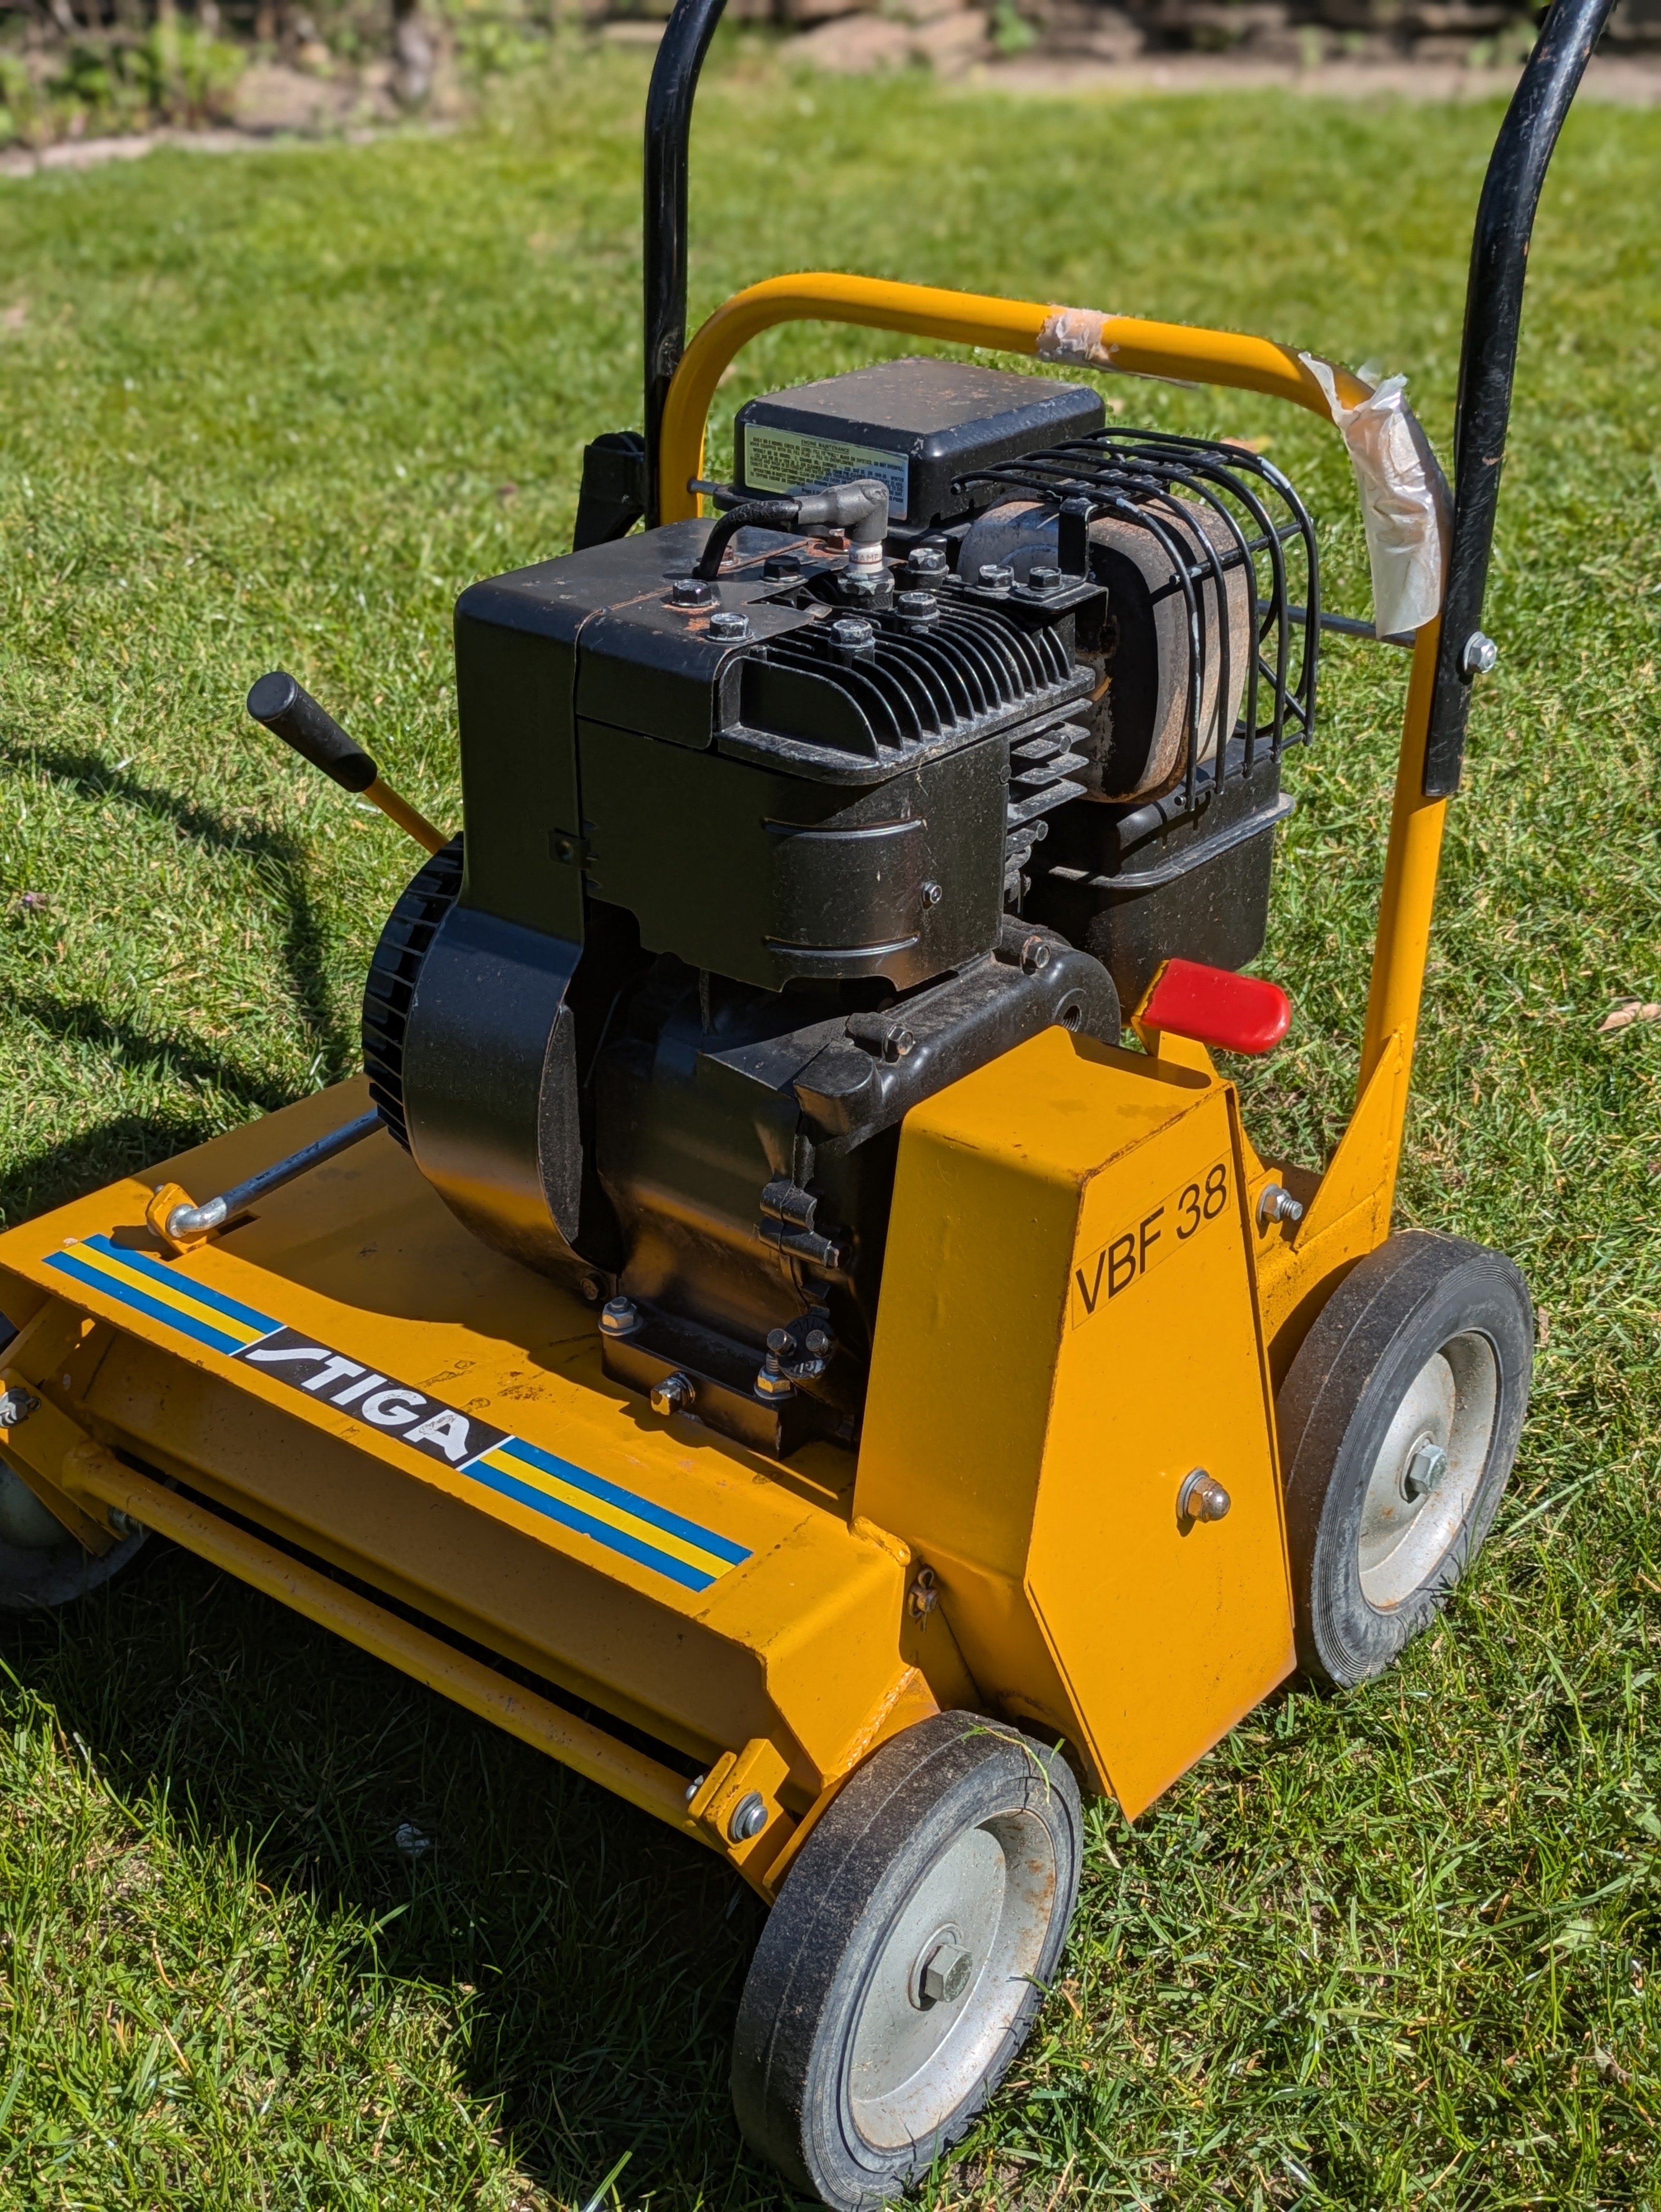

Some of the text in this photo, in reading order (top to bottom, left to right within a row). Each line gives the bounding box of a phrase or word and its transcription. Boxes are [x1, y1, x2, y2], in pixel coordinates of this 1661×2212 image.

[819, 442, 849, 453] MAINTENANCE
[1075, 1163, 1227, 1315] VBF 38
[245, 1348, 470, 1461] STIGA
